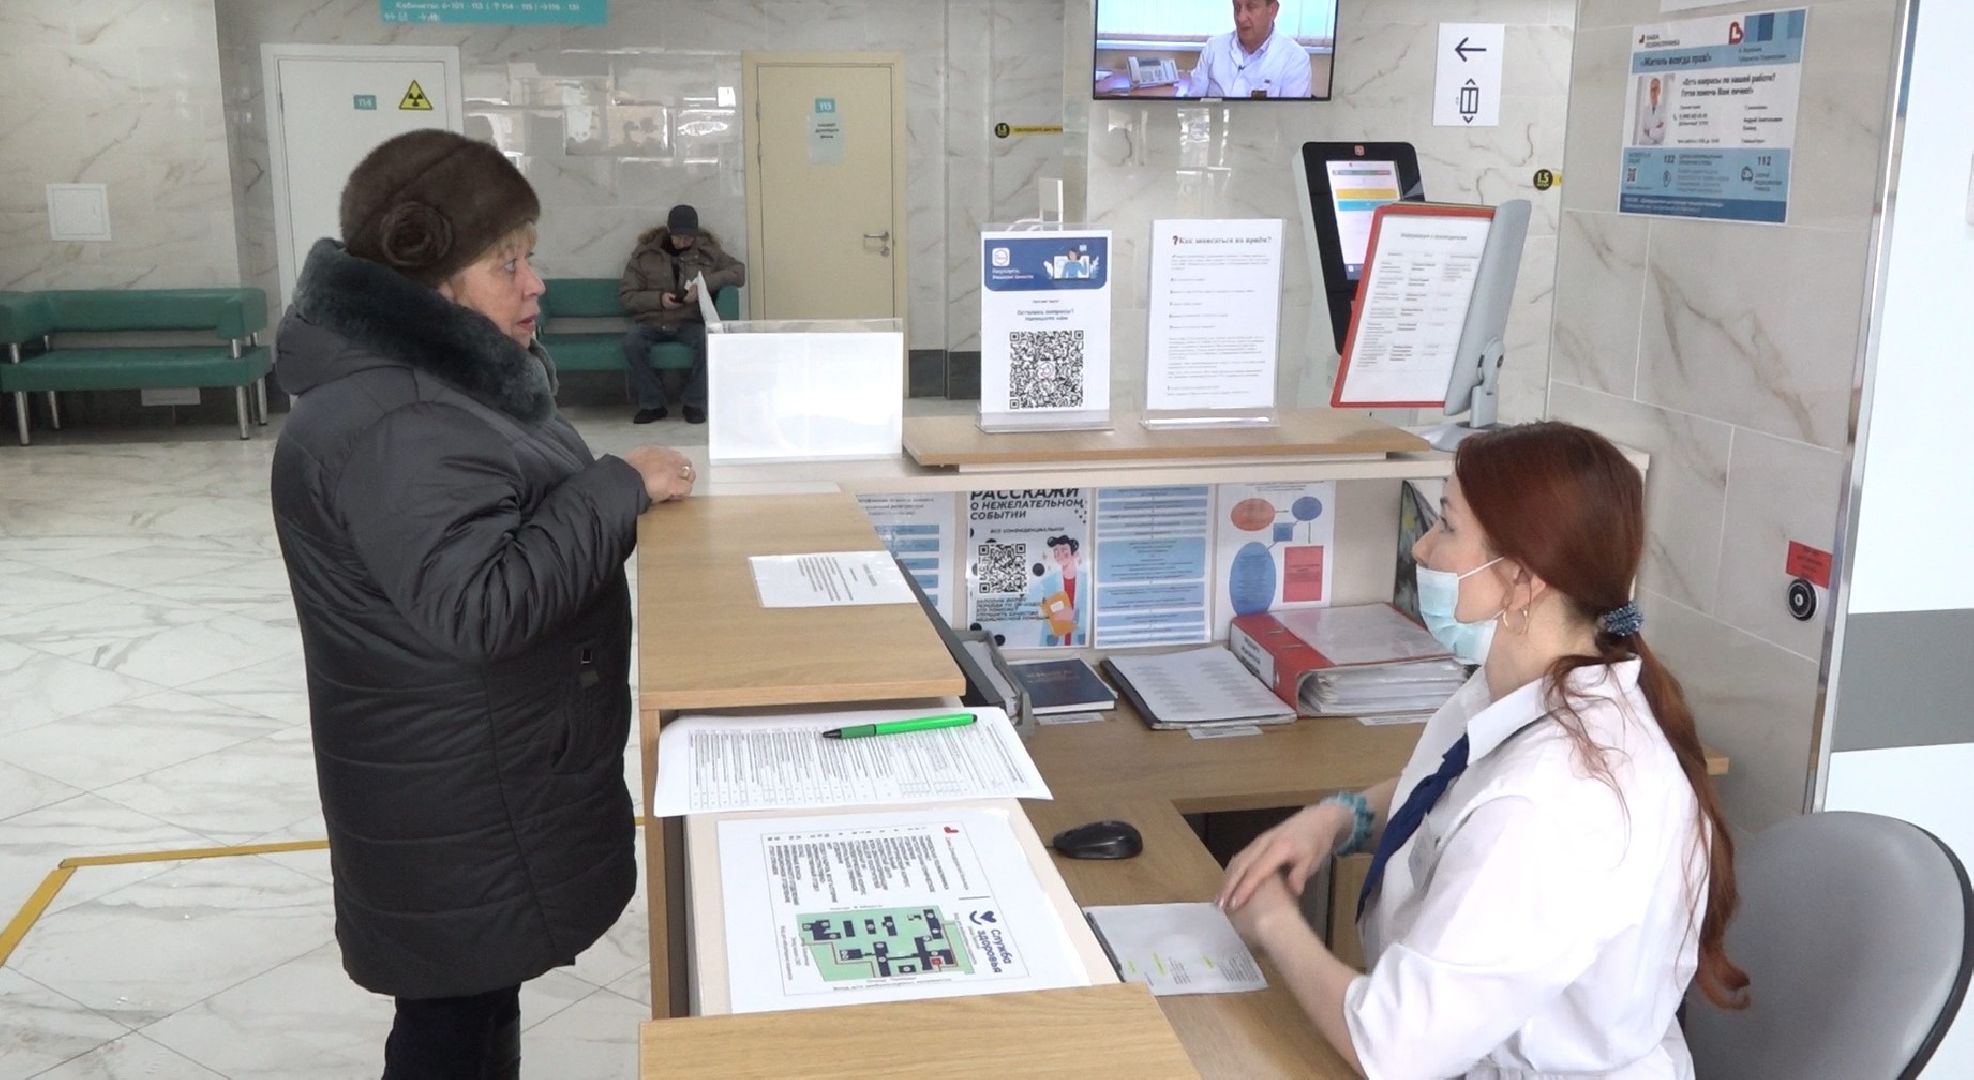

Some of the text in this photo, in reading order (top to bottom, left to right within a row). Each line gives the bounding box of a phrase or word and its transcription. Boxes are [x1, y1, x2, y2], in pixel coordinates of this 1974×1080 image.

[970, 488, 1080, 500] РАССКАЖИ
[970, 498, 1084, 511] О НЕЖЕЛАТЕЛЬНОМ
[970, 510, 1026, 520] СОБЫТИИ
[978, 930, 1002, 972] здоровья
[990, 929, 1012, 964] Служба
